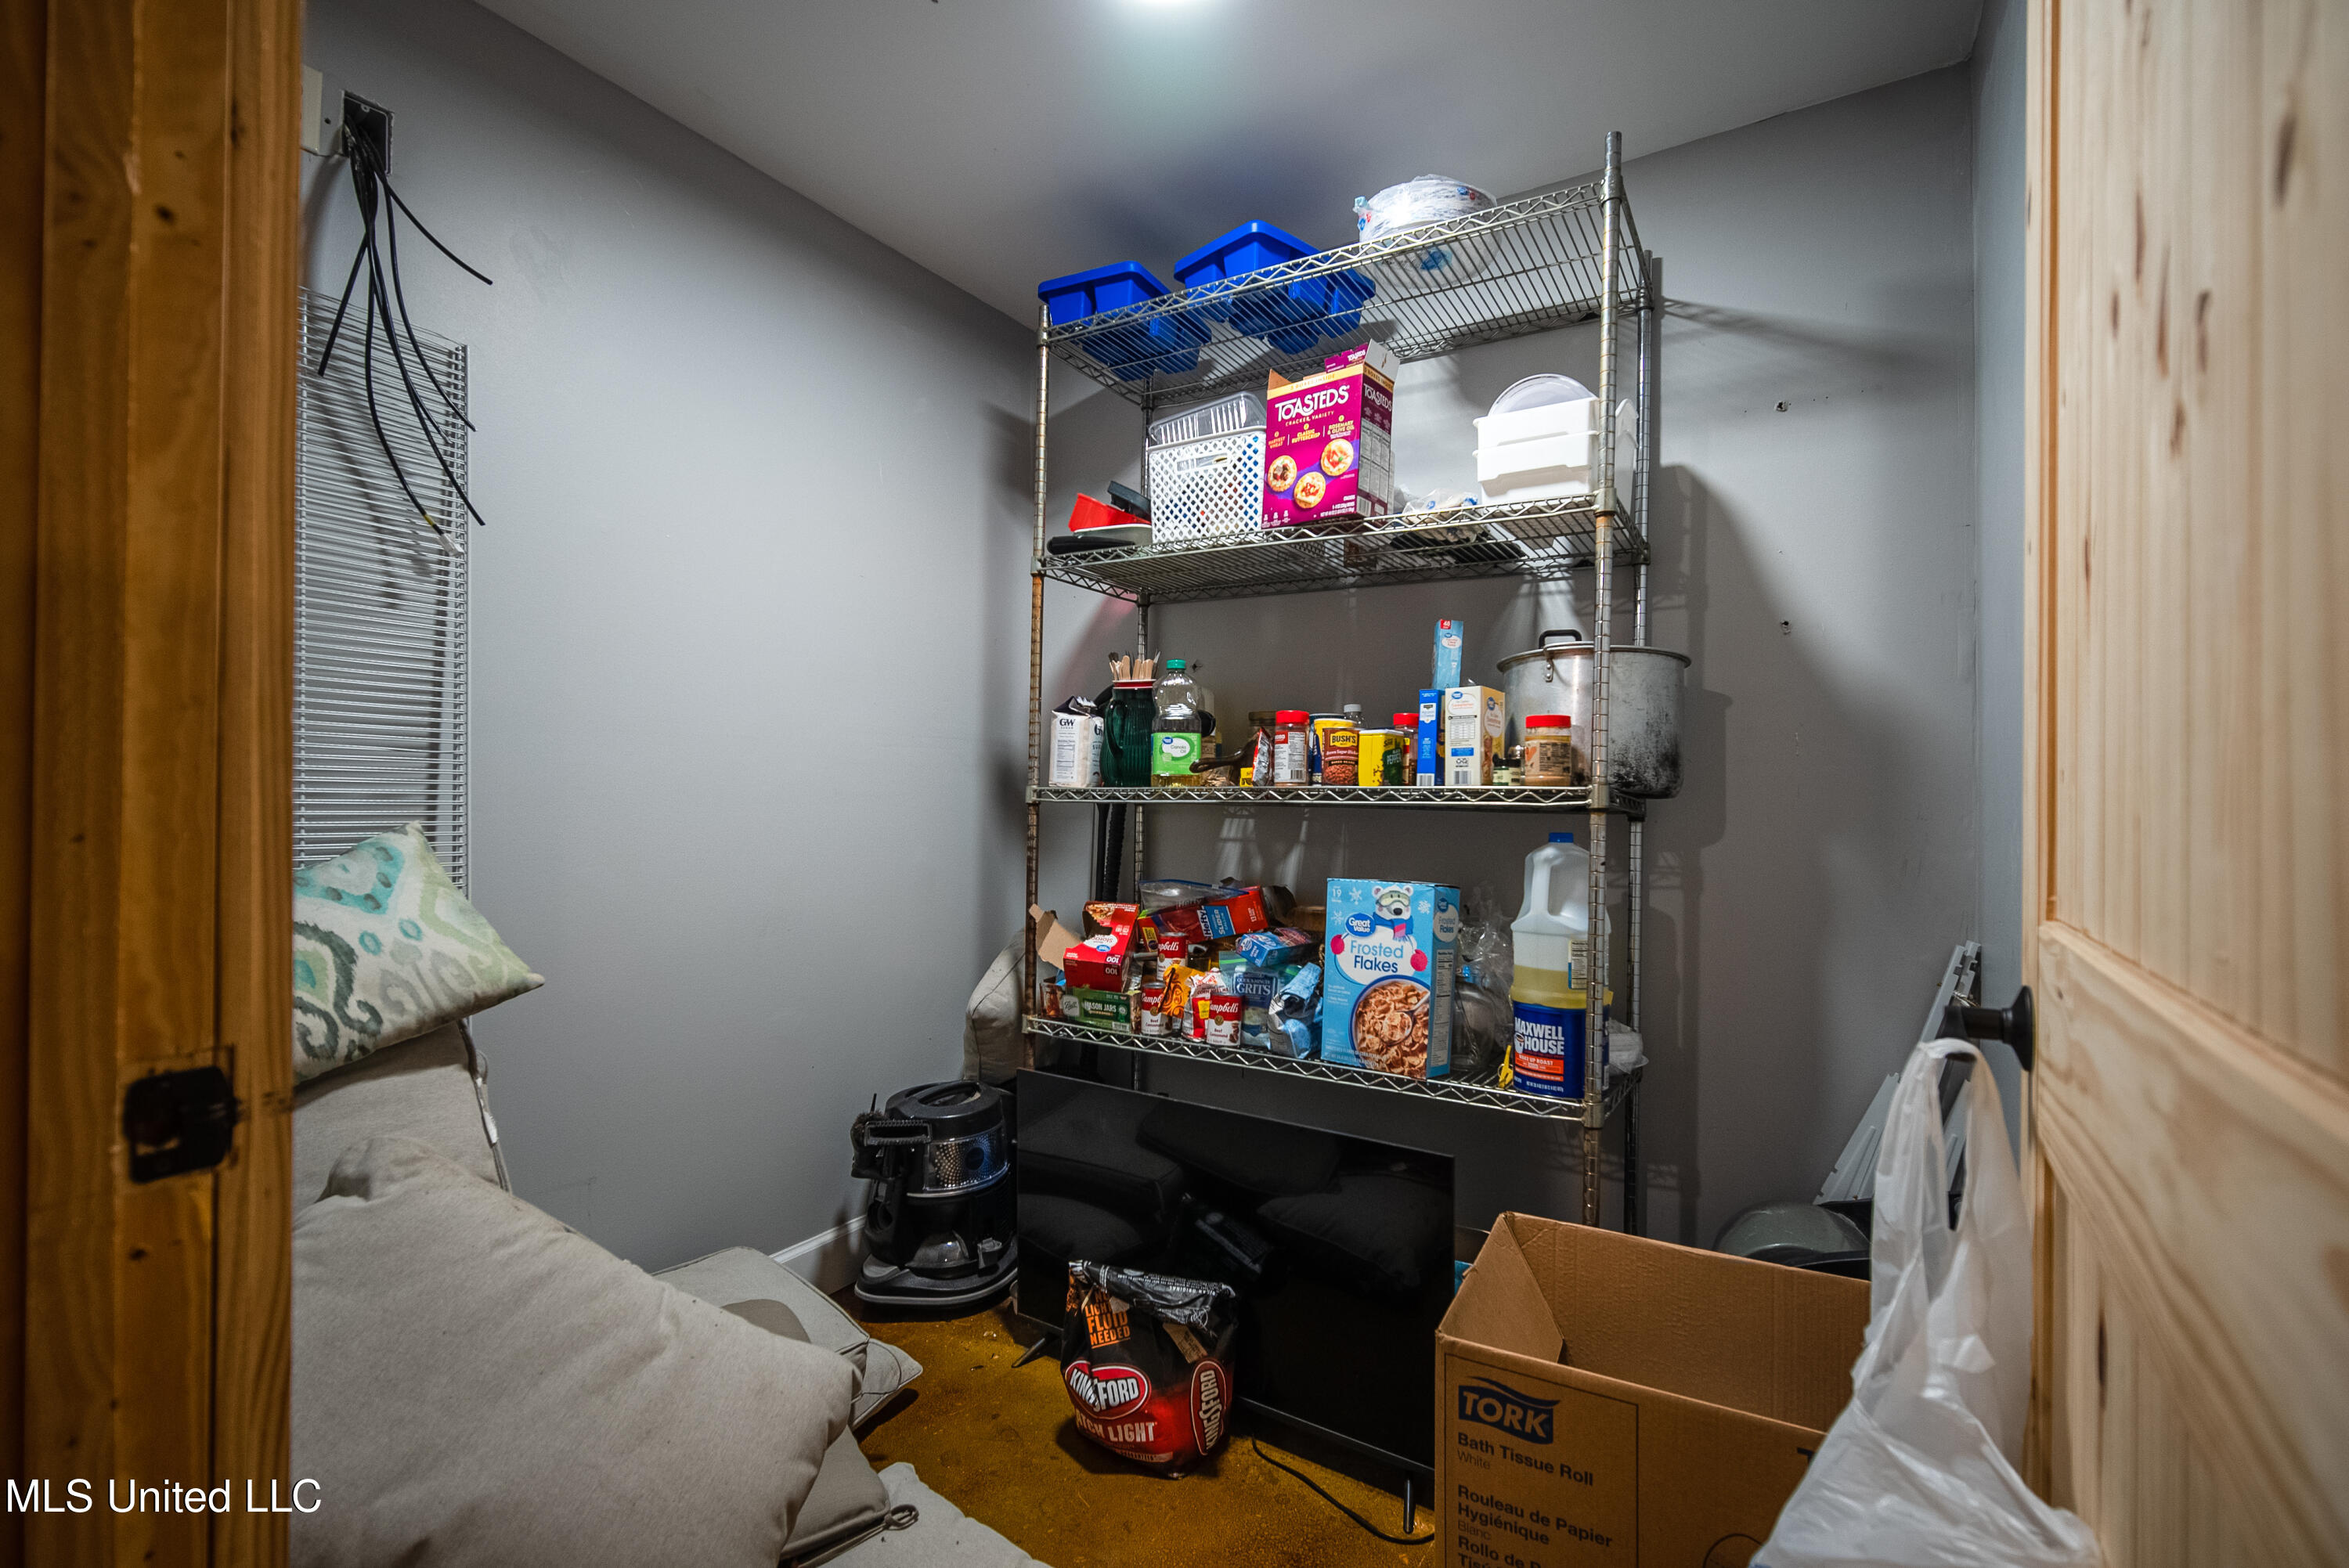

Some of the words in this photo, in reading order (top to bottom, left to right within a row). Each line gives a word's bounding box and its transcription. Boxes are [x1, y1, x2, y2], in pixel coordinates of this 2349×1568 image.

[1275, 386, 1349, 422] TOASTEDS
[1363, 383, 1392, 412] TOASTEDS
[1285, 416, 1312, 427] CRACKER
[1312, 410, 1335, 420] VARIETY
[1059, 718, 1076, 726] GW
[1332, 735, 1356, 744] BUSH'S
[1199, 910, 1212, 935] Hefty
[1348, 917, 1370, 928] Great
[1439, 925, 1454, 933] Flakes
[1351, 940, 1403, 959] Frosted
[1354, 955, 1398, 973] Flakes
[1236, 982, 1272, 995] GRITS
[1514, 1017, 1564, 1040] MAXWELL
[1525, 1036, 1564, 1055] HOUSE
[1087, 1311, 1128, 1333] FLUID
[1090, 1326, 1130, 1345] NEEDED
[1199, 1370, 1222, 1450] KINGSFORD
[1463, 1390, 1549, 1438] TORK
[1108, 1422, 1155, 1442] LIGHT
[1457, 1450, 1491, 1470] White
[1458, 1432, 1495, 1455] Bath
[1499, 1444, 1554, 1473] Tissue
[1560, 1463, 1593, 1486] Roll
[1458, 1484, 1525, 1518] Rouleau
[1529, 1510, 1550, 1527] de
[1556, 1517, 1613, 1548] Papier
[1458, 1502, 1550, 1545] Hygiénique
[1458, 1519, 1491, 1541] Blanc
[1458, 1535, 1499, 1561] Rollo
[1504, 1553, 1525, 1568] de
